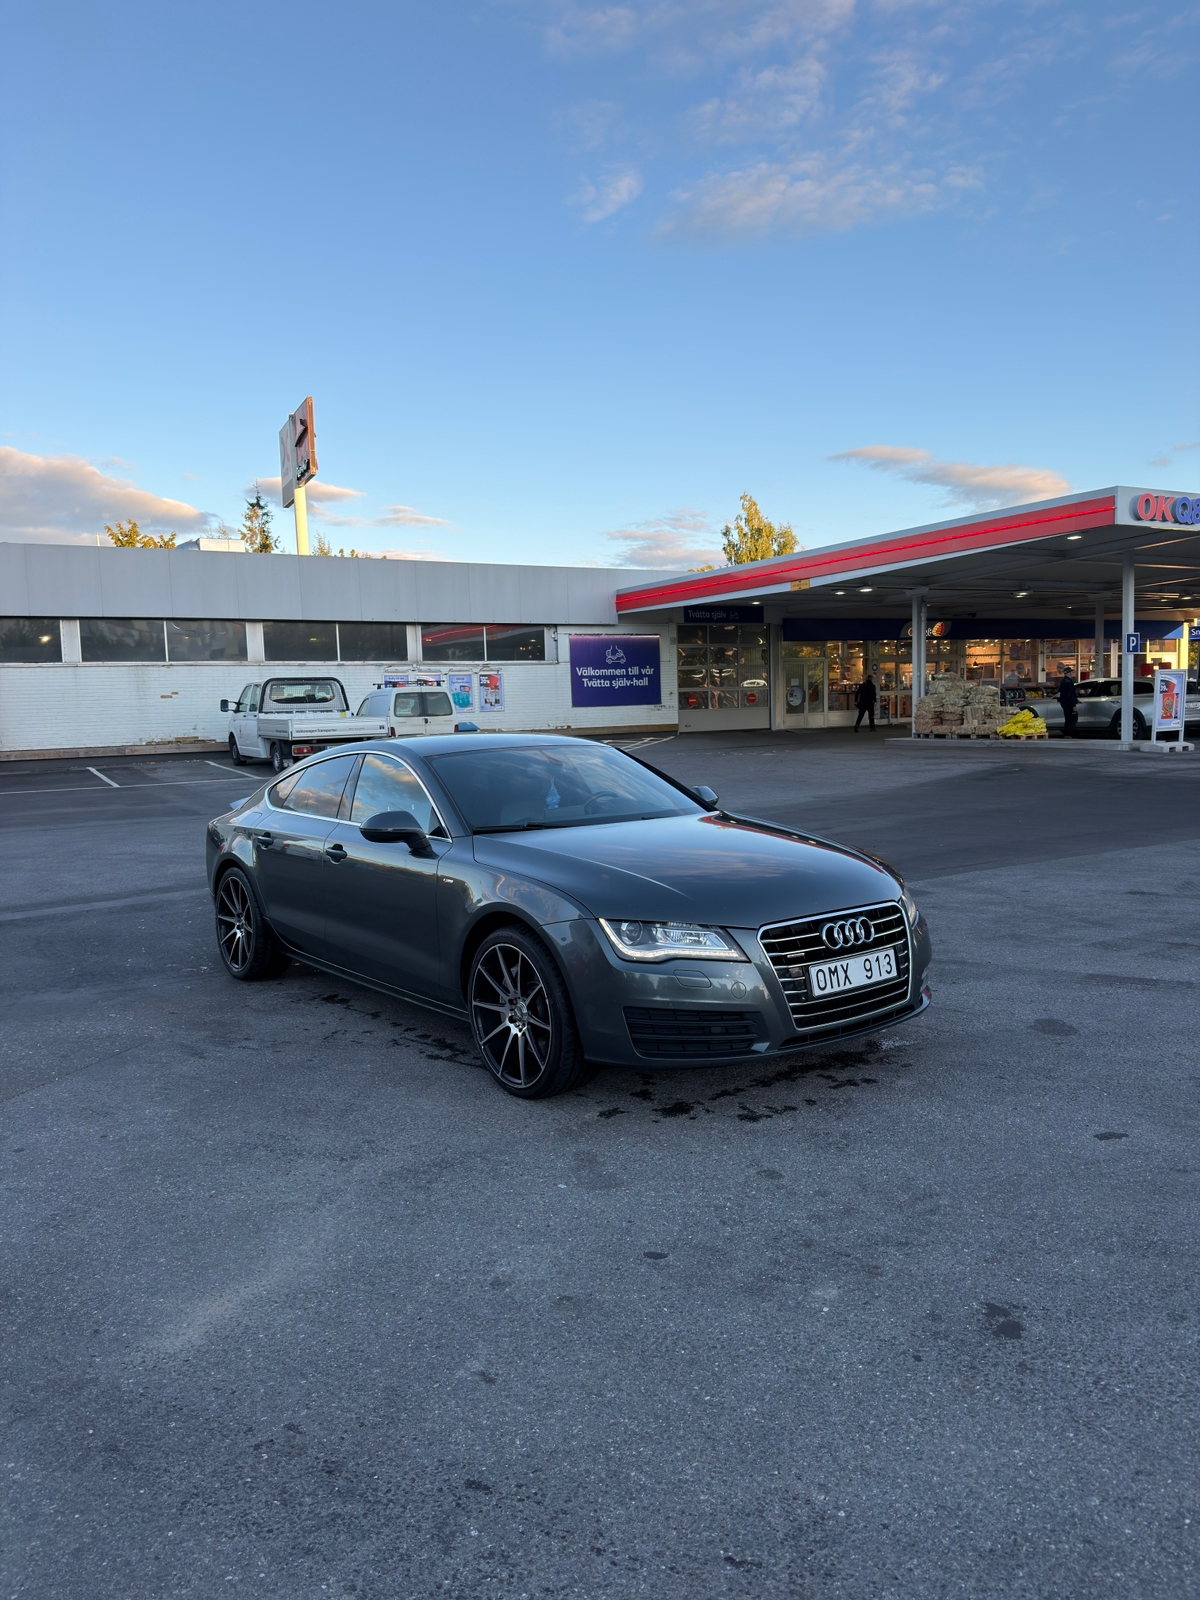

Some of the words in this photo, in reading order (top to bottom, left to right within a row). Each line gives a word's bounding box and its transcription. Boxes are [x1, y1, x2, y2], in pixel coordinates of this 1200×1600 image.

[687, 609, 710, 619] Tvätta
[711, 609, 727, 620] själv
[1129, 636, 1136, 651] P
[576, 667, 626, 677] Välkommen
[628, 666, 639, 675] till
[641, 665, 654, 675] vår
[582, 678, 610, 688] Tvätta
[611, 677, 649, 689] själv-hall
[816, 962, 852, 991] OMX
[863, 953, 893, 980] 913
